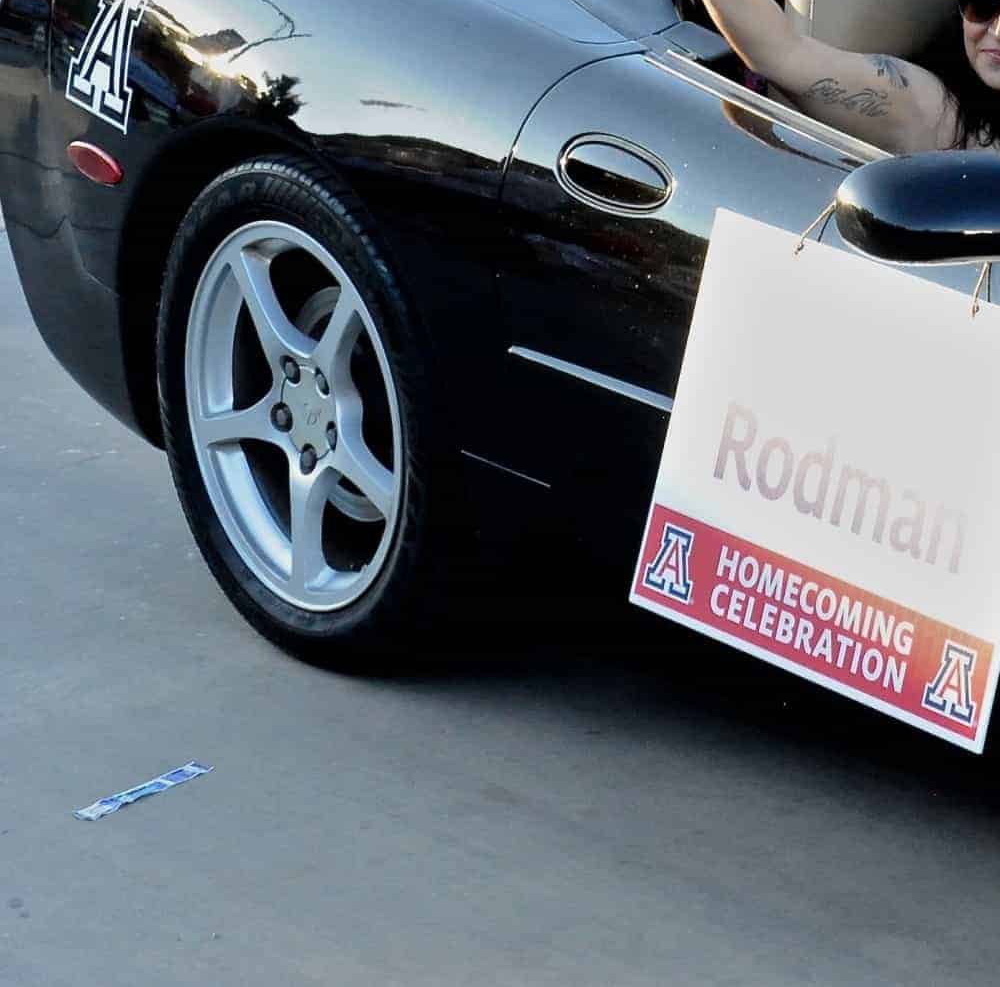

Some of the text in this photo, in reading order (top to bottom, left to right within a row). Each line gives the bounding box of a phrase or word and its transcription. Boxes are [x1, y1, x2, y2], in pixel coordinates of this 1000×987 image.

[713, 401, 966, 574] Rodman
[643, 523, 695, 605] A
[716, 545, 915, 655] HOMECOMING
[710, 584, 908, 693] CELEBRATION
[921, 639, 976, 726] A
